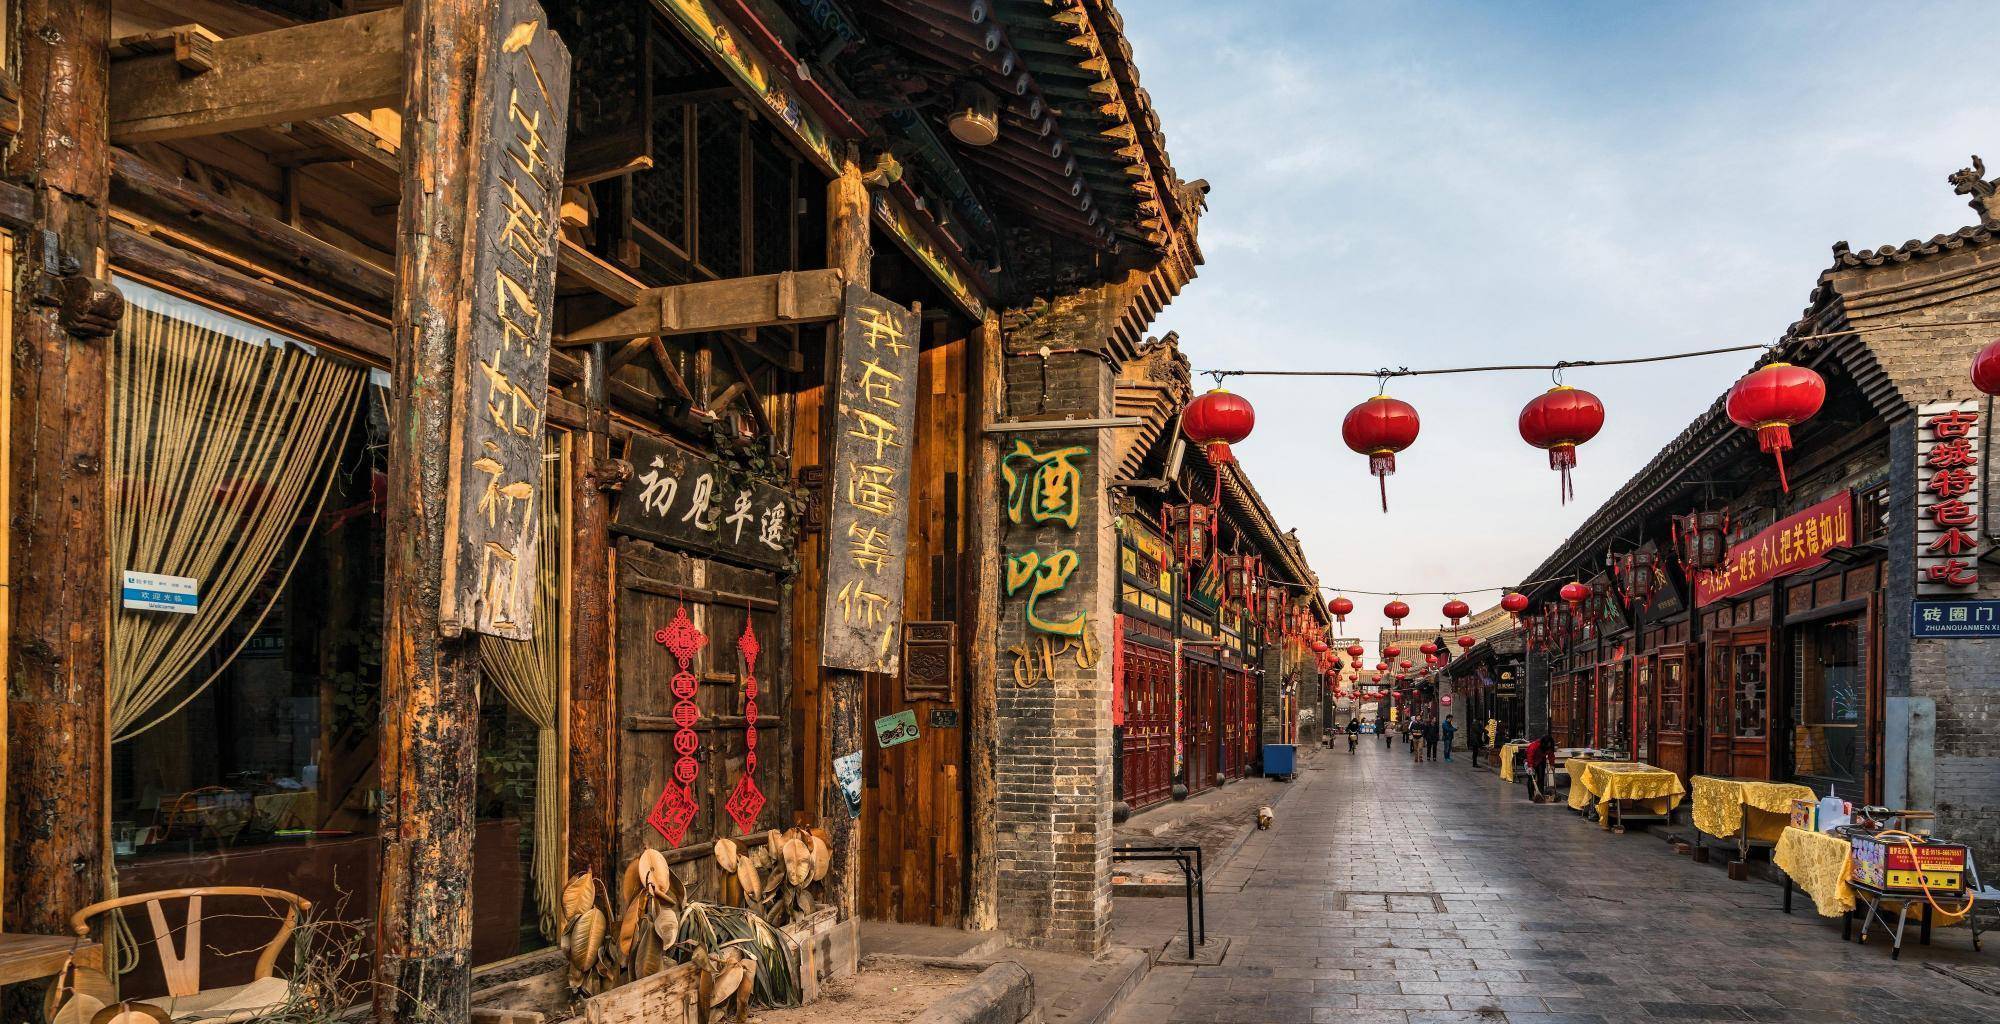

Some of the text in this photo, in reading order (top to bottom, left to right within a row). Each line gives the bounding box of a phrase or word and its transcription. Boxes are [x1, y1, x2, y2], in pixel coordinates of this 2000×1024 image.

[638, 454, 785, 551] 初见平遥
[1001, 438, 1091, 637] 酒吧
[1760, 504, 1848, 573] 众人把关稳如山
[1925, 408, 1979, 589] 古城特色小吃
[1922, 606, 1993, 622] 砖圈门
[1925, 624, 1991, 632] ZHUANQUANMEN
[672, 674, 698, 782] 萬事如意
